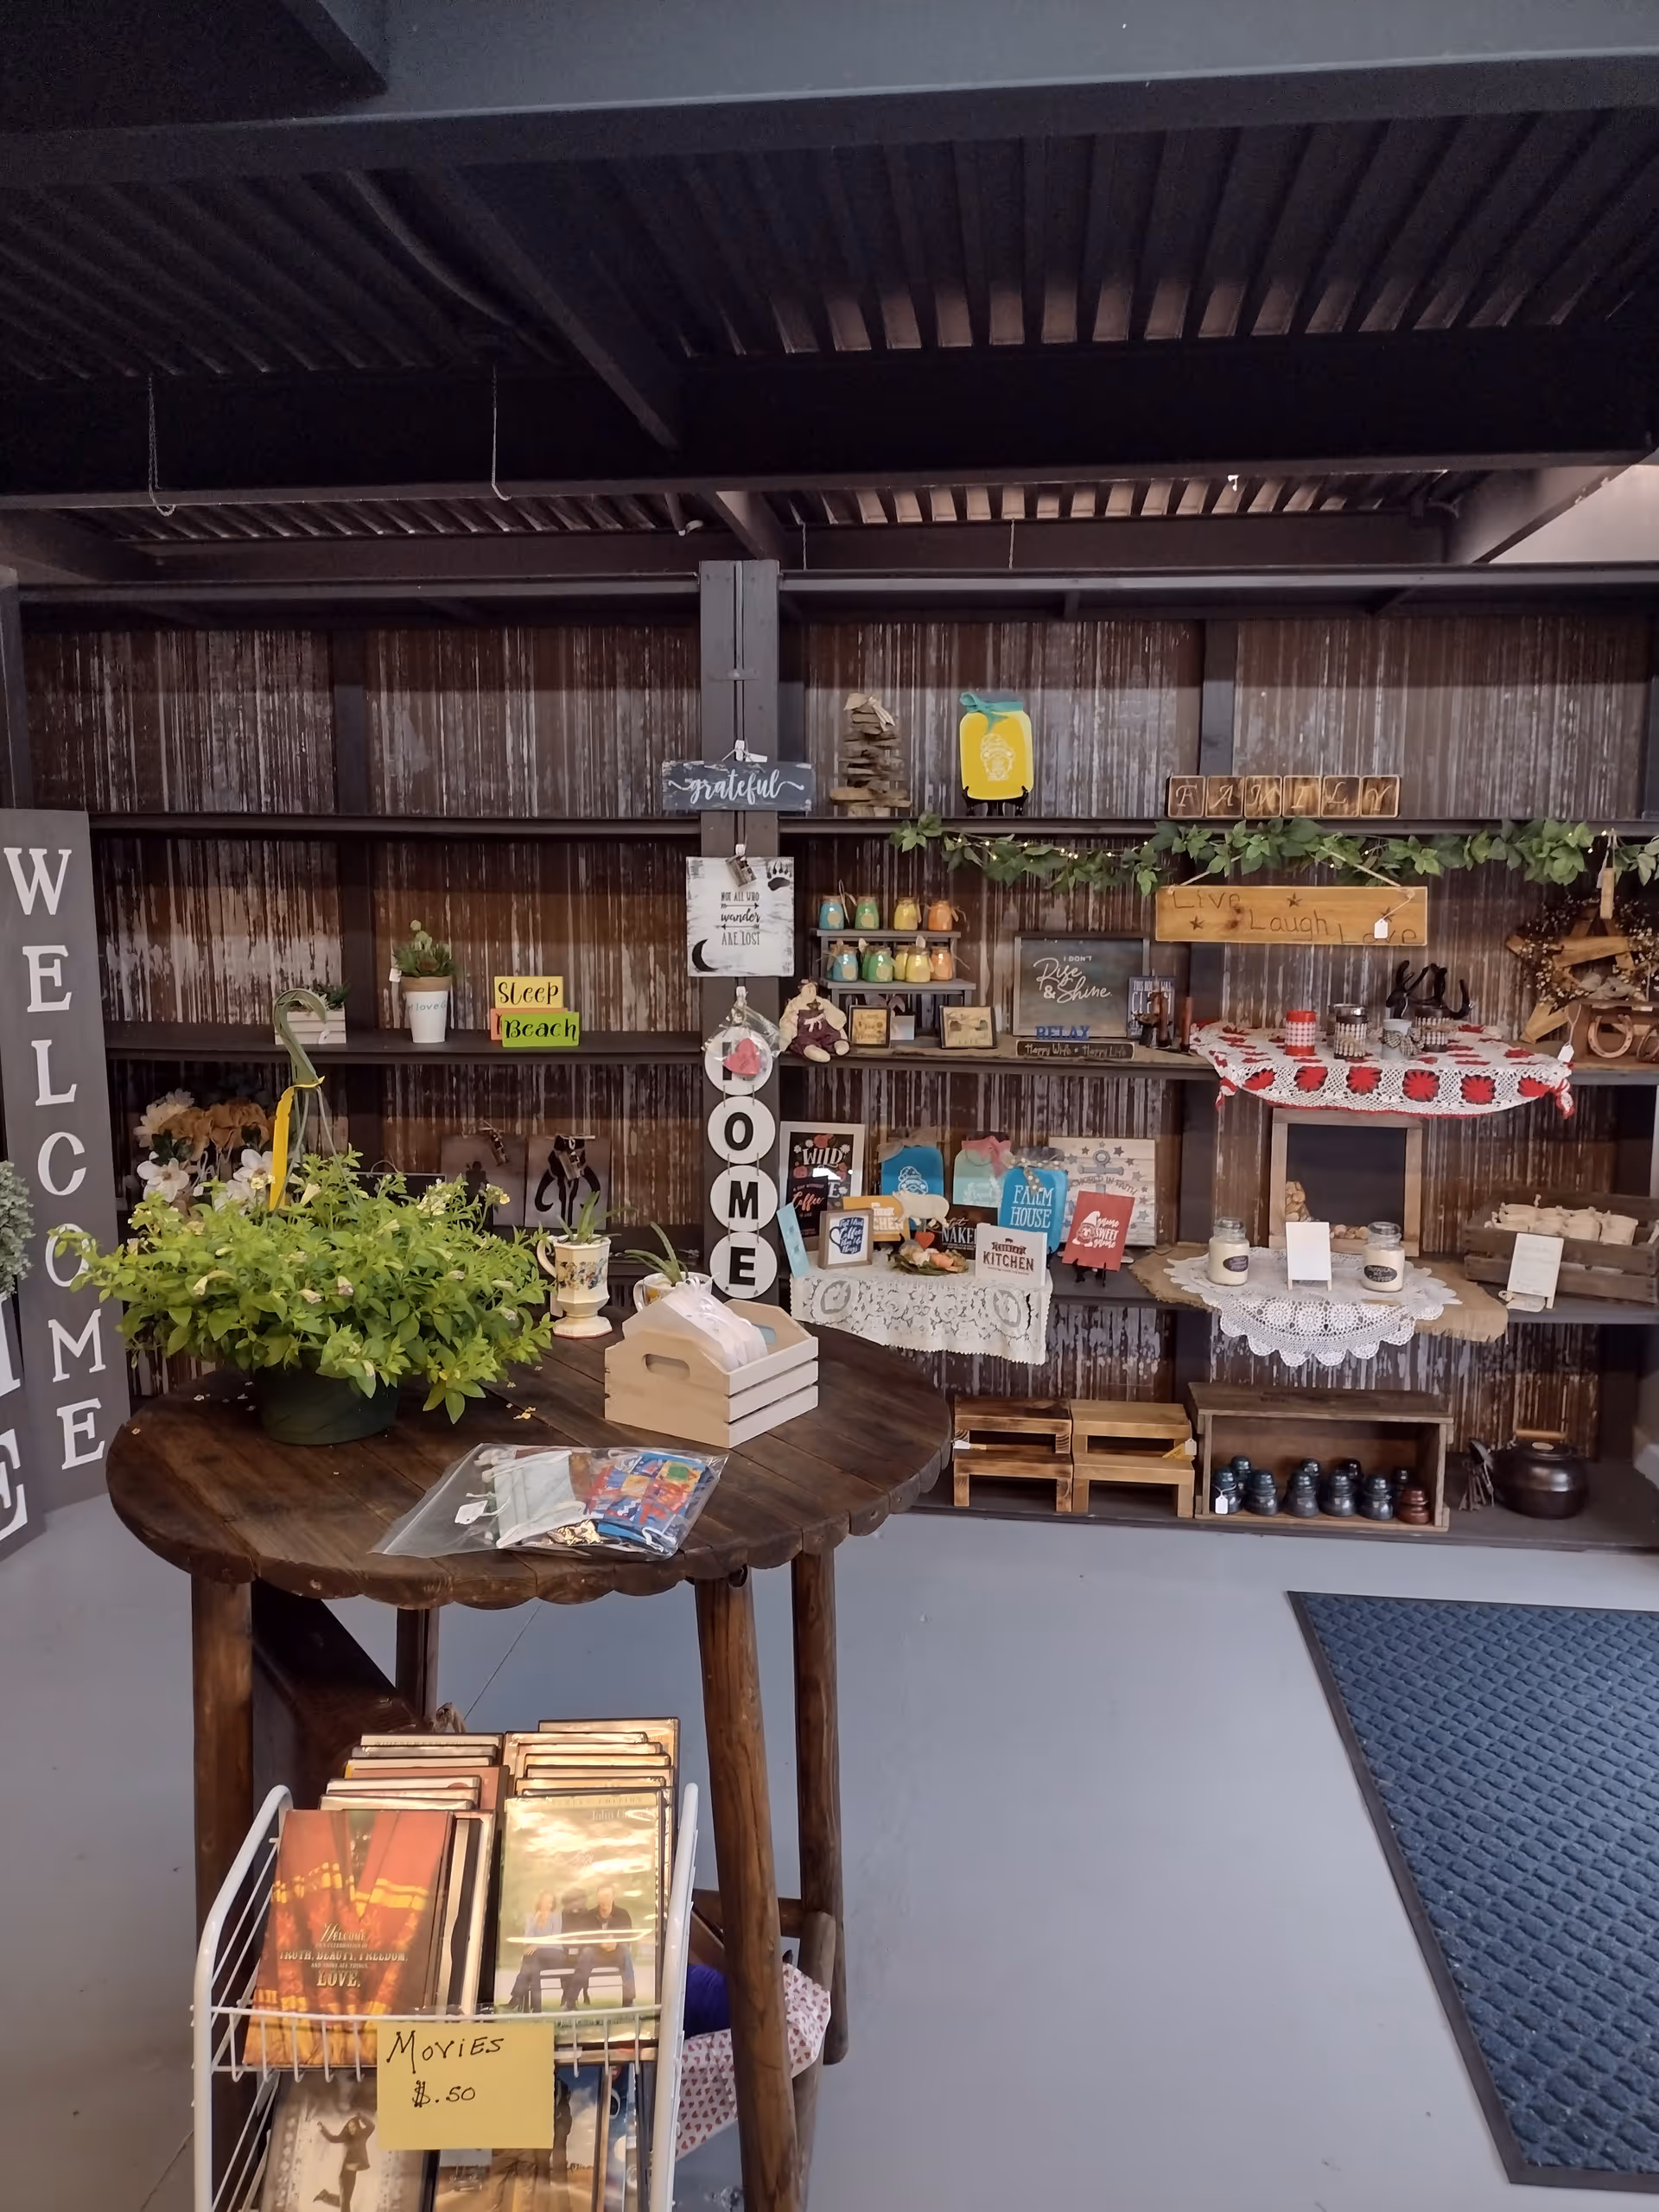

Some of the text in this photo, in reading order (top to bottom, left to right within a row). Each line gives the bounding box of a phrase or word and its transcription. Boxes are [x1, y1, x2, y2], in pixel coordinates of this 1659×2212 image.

[669, 769, 804, 805] grateful
[1174, 781, 1392, 812] FAMILY
[721, 892, 760, 902] NOT ALL WHO
[1173, 890, 1242, 910] Live
[721, 908, 761, 922] wander
[1250, 908, 1330, 942] Laugh
[721, 932, 760, 945] ARE LOST
[1033, 957, 1083, 990] Rise
[1043, 985, 1056, 999] &
[505, 1018, 577, 1041] Beach
[1035, 1026, 1090, 1040] RELAX
[1025, 1044, 1050, 1057] Happy
[3, 847, 107, 1470] WELCOME
[802, 1147, 844, 1166] WILD
[1009, 1206, 1052, 1228] HOUSE
[1096, 1227, 1119, 1242] SWEET
[982, 1250, 1035, 1272] KITCHEN
